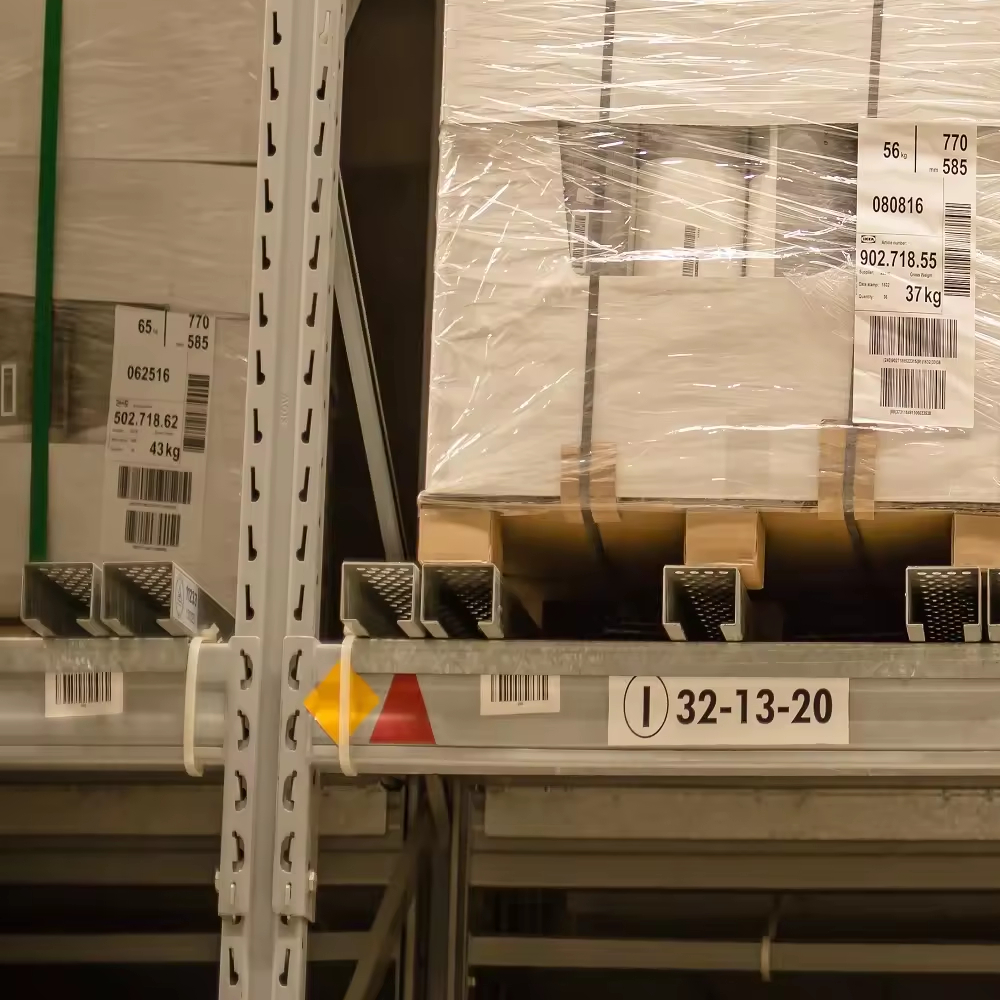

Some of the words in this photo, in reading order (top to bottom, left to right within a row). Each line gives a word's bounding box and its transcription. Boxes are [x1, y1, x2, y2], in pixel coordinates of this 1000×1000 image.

[883, 142, 900, 159] 56
[943, 134, 968, 151] 770
[942, 158, 968, 175] 585
[872, 196, 924, 214] 080816
[860, 249, 937, 269] 902.718.55
[138, 319, 152, 334] 65
[188, 313, 210, 330] 770
[187, 334, 209, 350] 585
[127, 365, 170, 383] 062516
[113, 411, 179, 429] 502.718.62
[676, 687, 833, 725] 32-13-20
